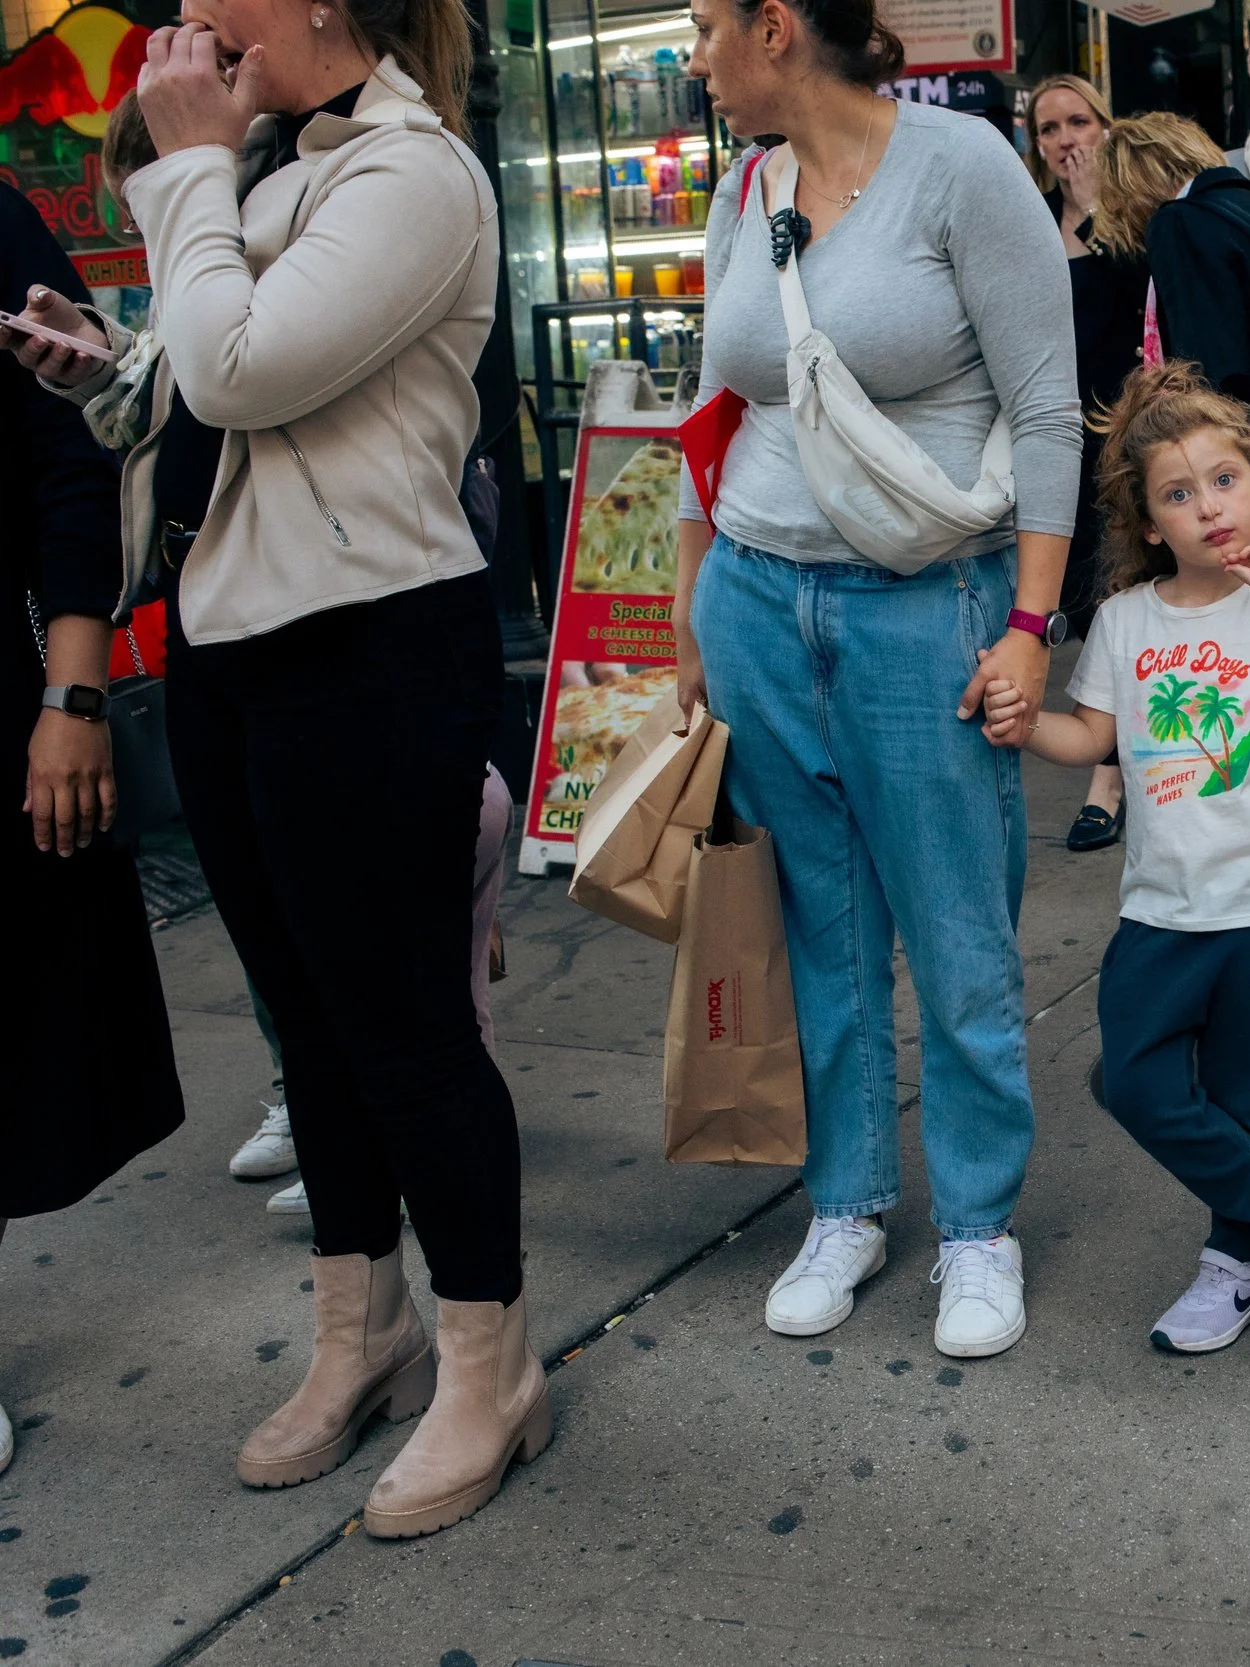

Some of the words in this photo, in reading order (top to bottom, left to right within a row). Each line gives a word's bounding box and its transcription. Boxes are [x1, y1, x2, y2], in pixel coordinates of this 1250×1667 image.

[957, 81, 985, 97] 24h
[84, 259, 136, 282] WHITE
[588, 626, 599, 639] 2
[601, 627, 654, 641] CHEESE
[606, 642, 637, 656] CAN
[1136, 643, 1188, 681] Chill
[1161, 770, 1196, 789] PERFECT
[1156, 788, 1183, 807] WAVES
